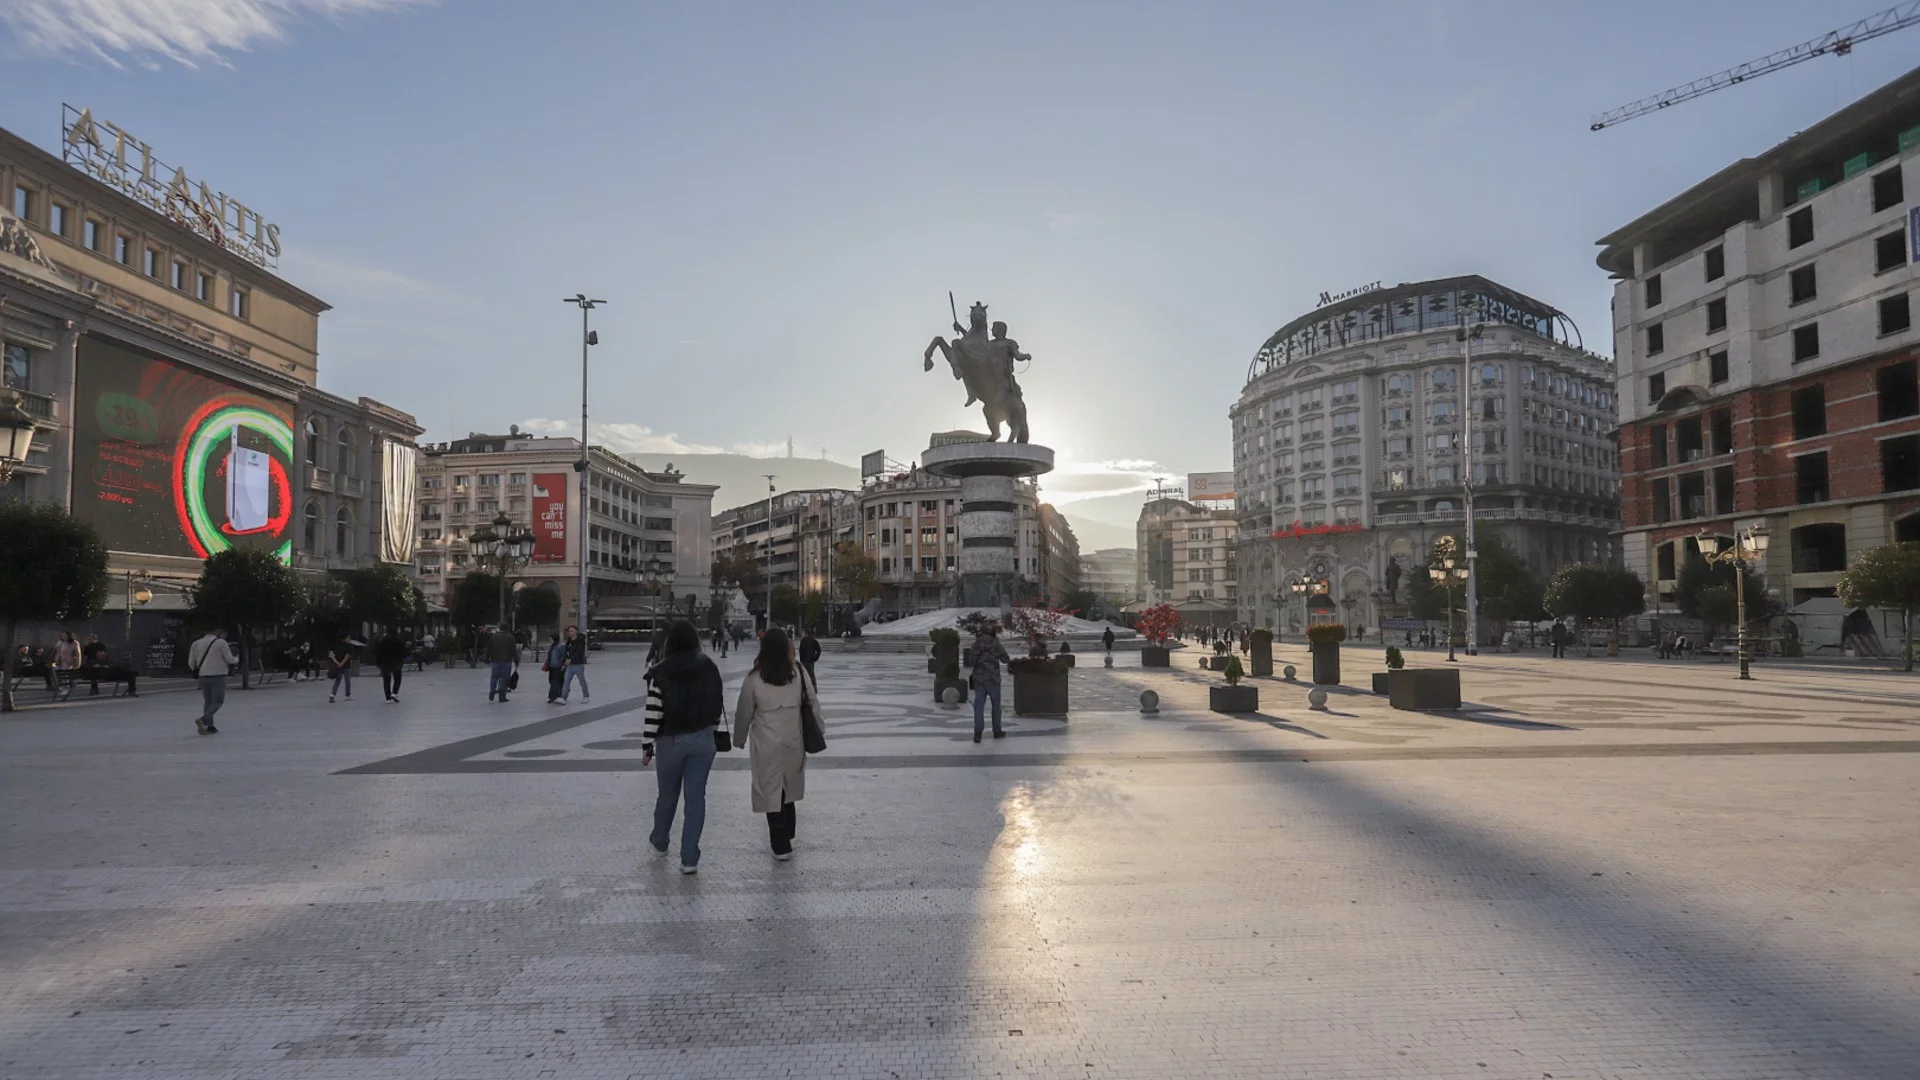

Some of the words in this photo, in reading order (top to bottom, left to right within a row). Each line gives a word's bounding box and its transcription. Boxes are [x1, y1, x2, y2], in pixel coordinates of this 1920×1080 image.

[68, 107, 281, 258] ATLANTIS
[1332, 280, 1382, 302] MARRIOTT
[1146, 487, 1184, 496] ADMIRAL
[550, 502, 564, 513] you
[541, 510, 564, 520] can't
[544, 521, 564, 530] miss
[551, 531, 564, 539] me
